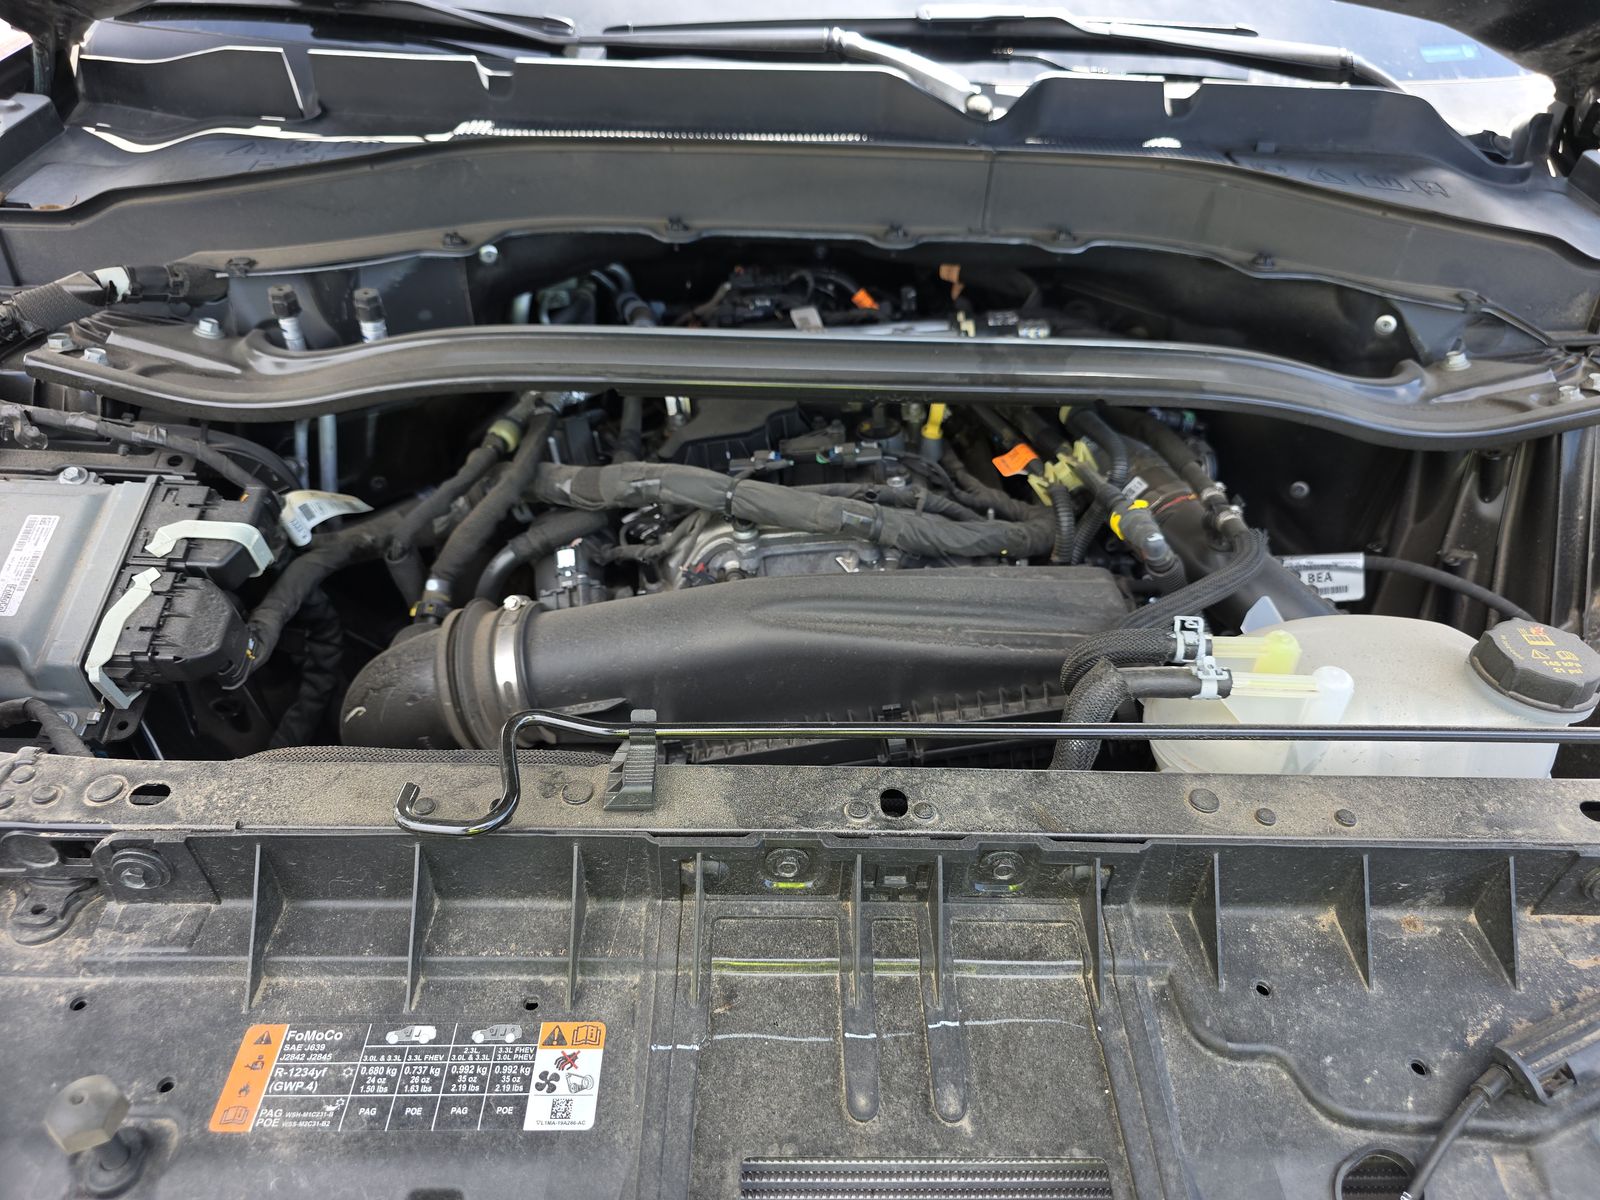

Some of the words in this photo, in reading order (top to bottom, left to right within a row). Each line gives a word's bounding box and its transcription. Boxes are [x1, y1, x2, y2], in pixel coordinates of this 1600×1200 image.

[1307, 572, 1332, 583] BEA
[286, 1030, 343, 1041] FoMoCo
[280, 1053, 305, 1061] J2842
[306, 1053, 332, 1061] J2845
[274, 1067, 328, 1079] R-1234yf
[360, 1066, 385, 1075] 0.680
[386, 1066, 398, 1077] kg
[404, 1066, 428, 1075] 0.737
[430, 1066, 441, 1077] kg
[451, 1065, 475, 1074] 0.992
[476, 1065, 488, 1076] kg
[494, 1065, 518, 1074] 0.992
[520, 1065, 531, 1076] kg
[366, 1076, 375, 1084] 24
[410, 1076, 419, 1084] 26
[457, 1075, 467, 1083] 35
[269, 1081, 303, 1093] (GWP
[304, 1081, 318, 1093] 4)
[360, 1085, 375, 1093] 1.50
[376, 1085, 388, 1093] lbs
[420, 1085, 432, 1093] lbs
[451, 1084, 467, 1092] 2.19
[468, 1084, 480, 1092] lbs
[495, 1084, 511, 1092] 2.19
[512, 1084, 524, 1092] lbs
[259, 1108, 283, 1118] PAG
[358, 1108, 377, 1116] PAG
[405, 1107, 423, 1116] POE
[255, 1118, 280, 1127] POE
